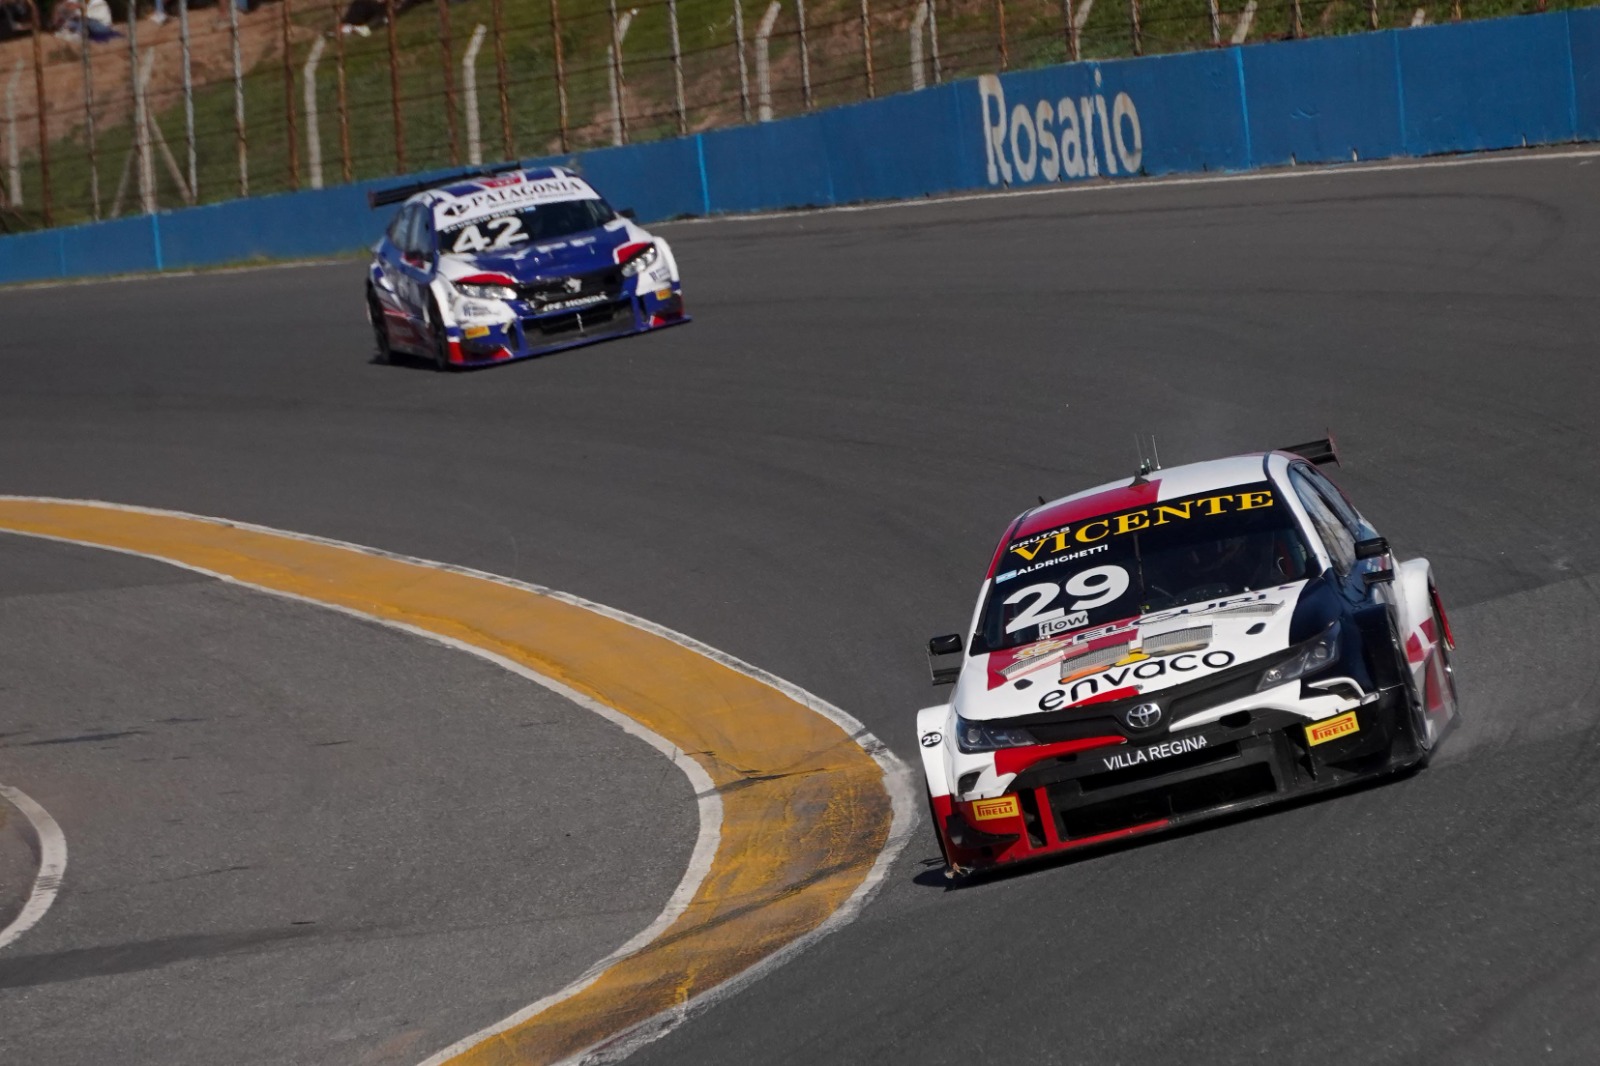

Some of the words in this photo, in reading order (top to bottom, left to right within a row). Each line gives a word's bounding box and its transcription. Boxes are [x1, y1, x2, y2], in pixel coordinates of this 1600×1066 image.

[978, 67, 1142, 184] Rosario
[472, 179, 582, 207] PATAGONIA
[452, 216, 530, 253] 42
[1010, 490, 1274, 561] VICENTE
[1010, 526, 1071, 551] FRUTAS
[1017, 543, 1109, 576] ALDRIGHETTI
[1003, 564, 1130, 635] 29
[1041, 614, 1086, 634] flow
[1038, 650, 1236, 711] envaco
[923, 733, 941, 746] 29
[1311, 716, 1355, 741] PIRELLI
[1103, 748, 1148, 771] VILLA
[1148, 735, 1208, 762] REGINA
[977, 801, 1014, 818] PIRELLI
